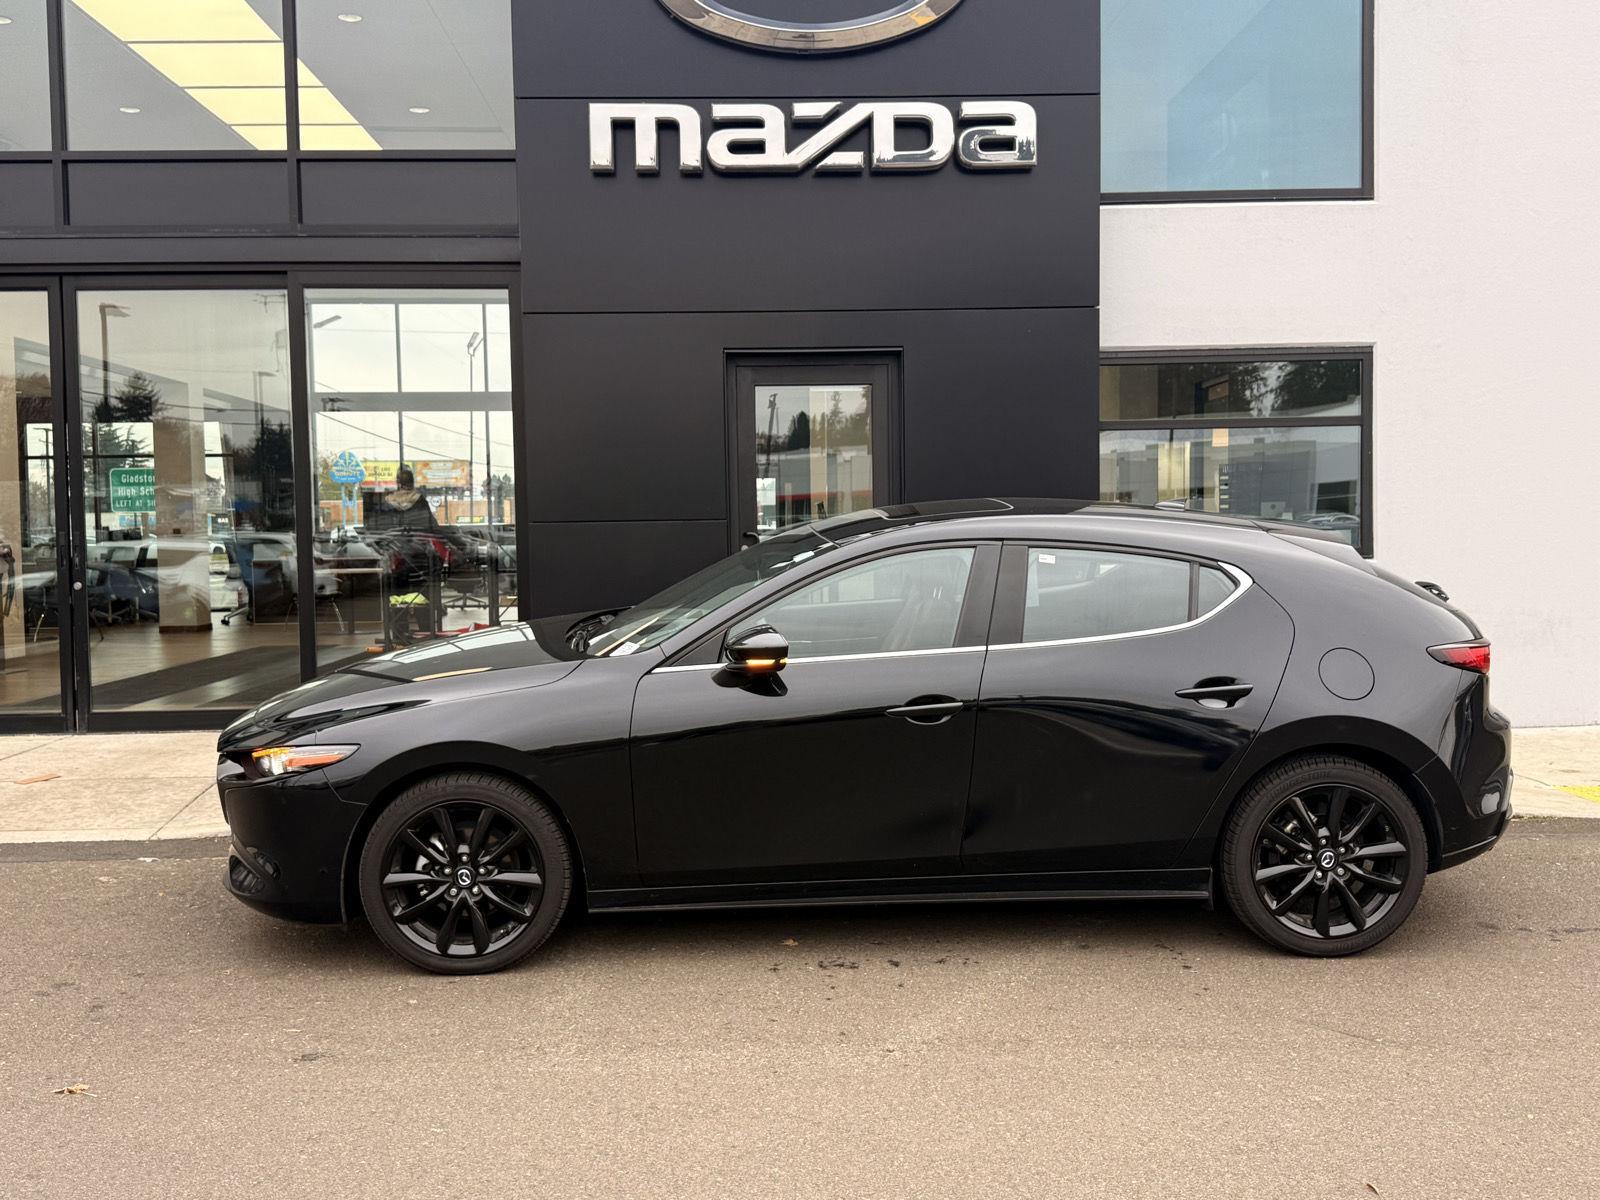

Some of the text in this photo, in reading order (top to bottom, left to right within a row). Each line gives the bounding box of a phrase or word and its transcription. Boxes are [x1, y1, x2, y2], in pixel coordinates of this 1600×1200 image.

[118, 486, 136, 498] High
[116, 500, 132, 508] LEFT
[136, 499, 143, 507] AT
